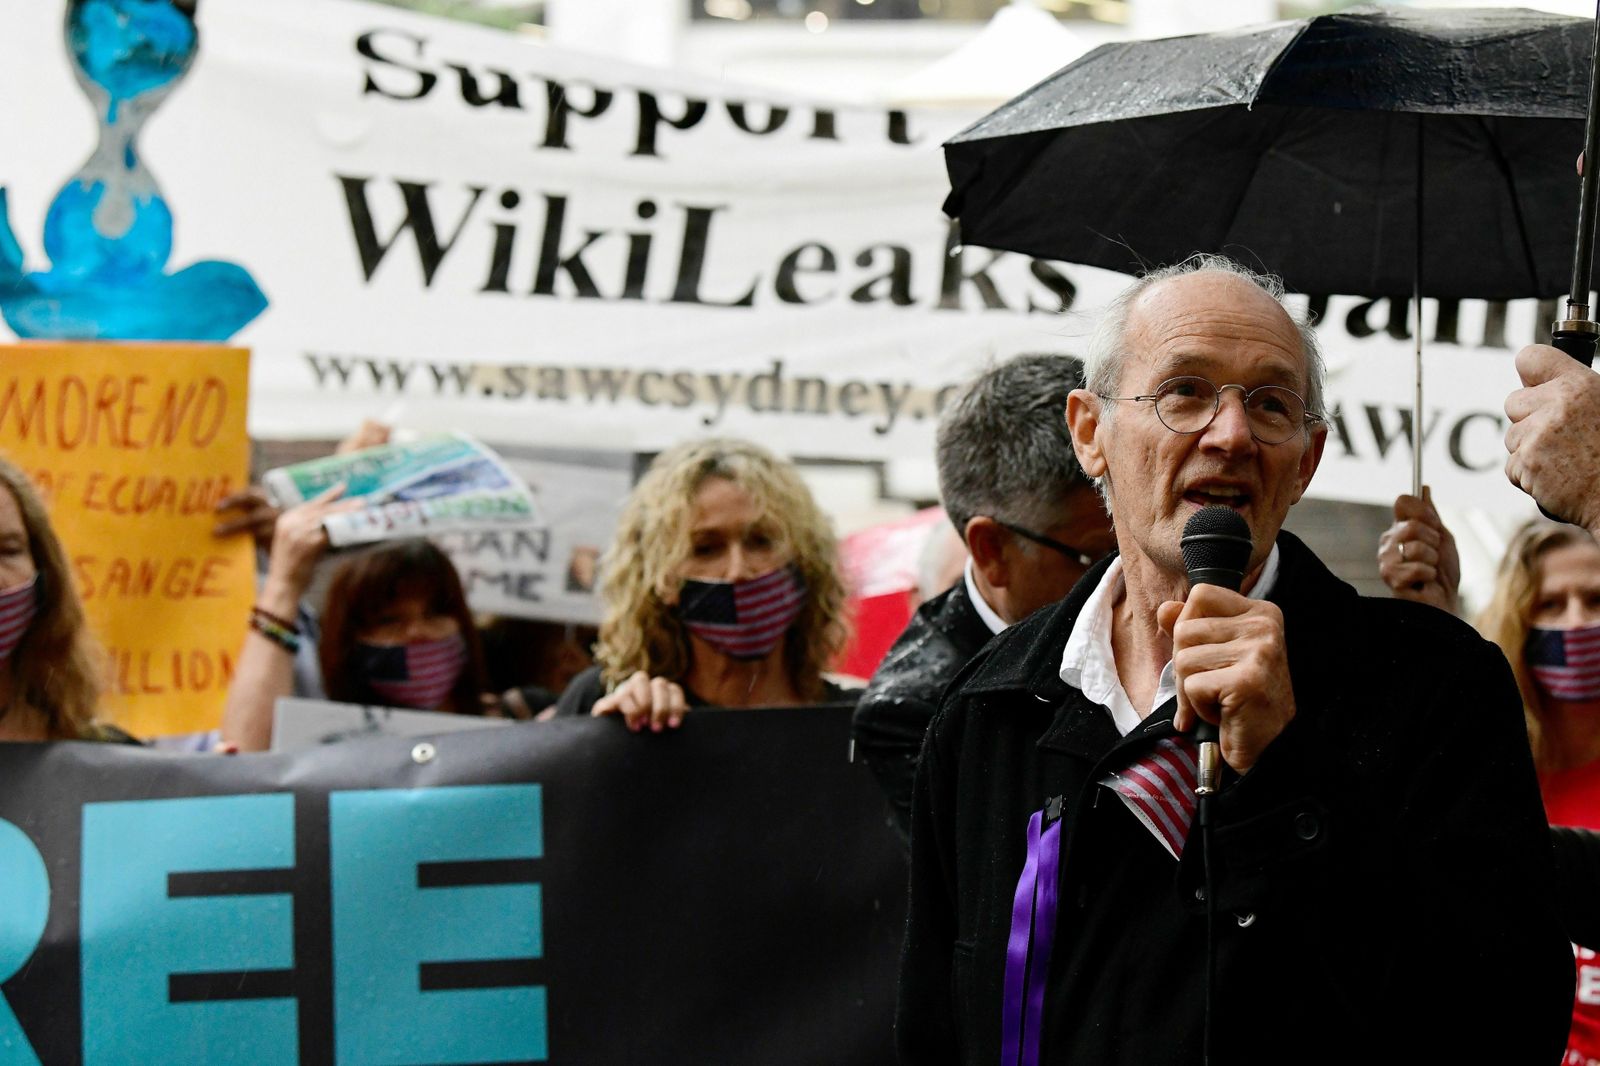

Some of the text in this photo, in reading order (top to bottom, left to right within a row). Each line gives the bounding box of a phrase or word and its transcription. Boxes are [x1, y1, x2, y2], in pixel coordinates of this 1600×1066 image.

[355, 27, 926, 158] Support
[334, 173, 1078, 315] WikiLeaks
[0, 374, 229, 452] MORENO
[0, 783, 549, 1066] EE
